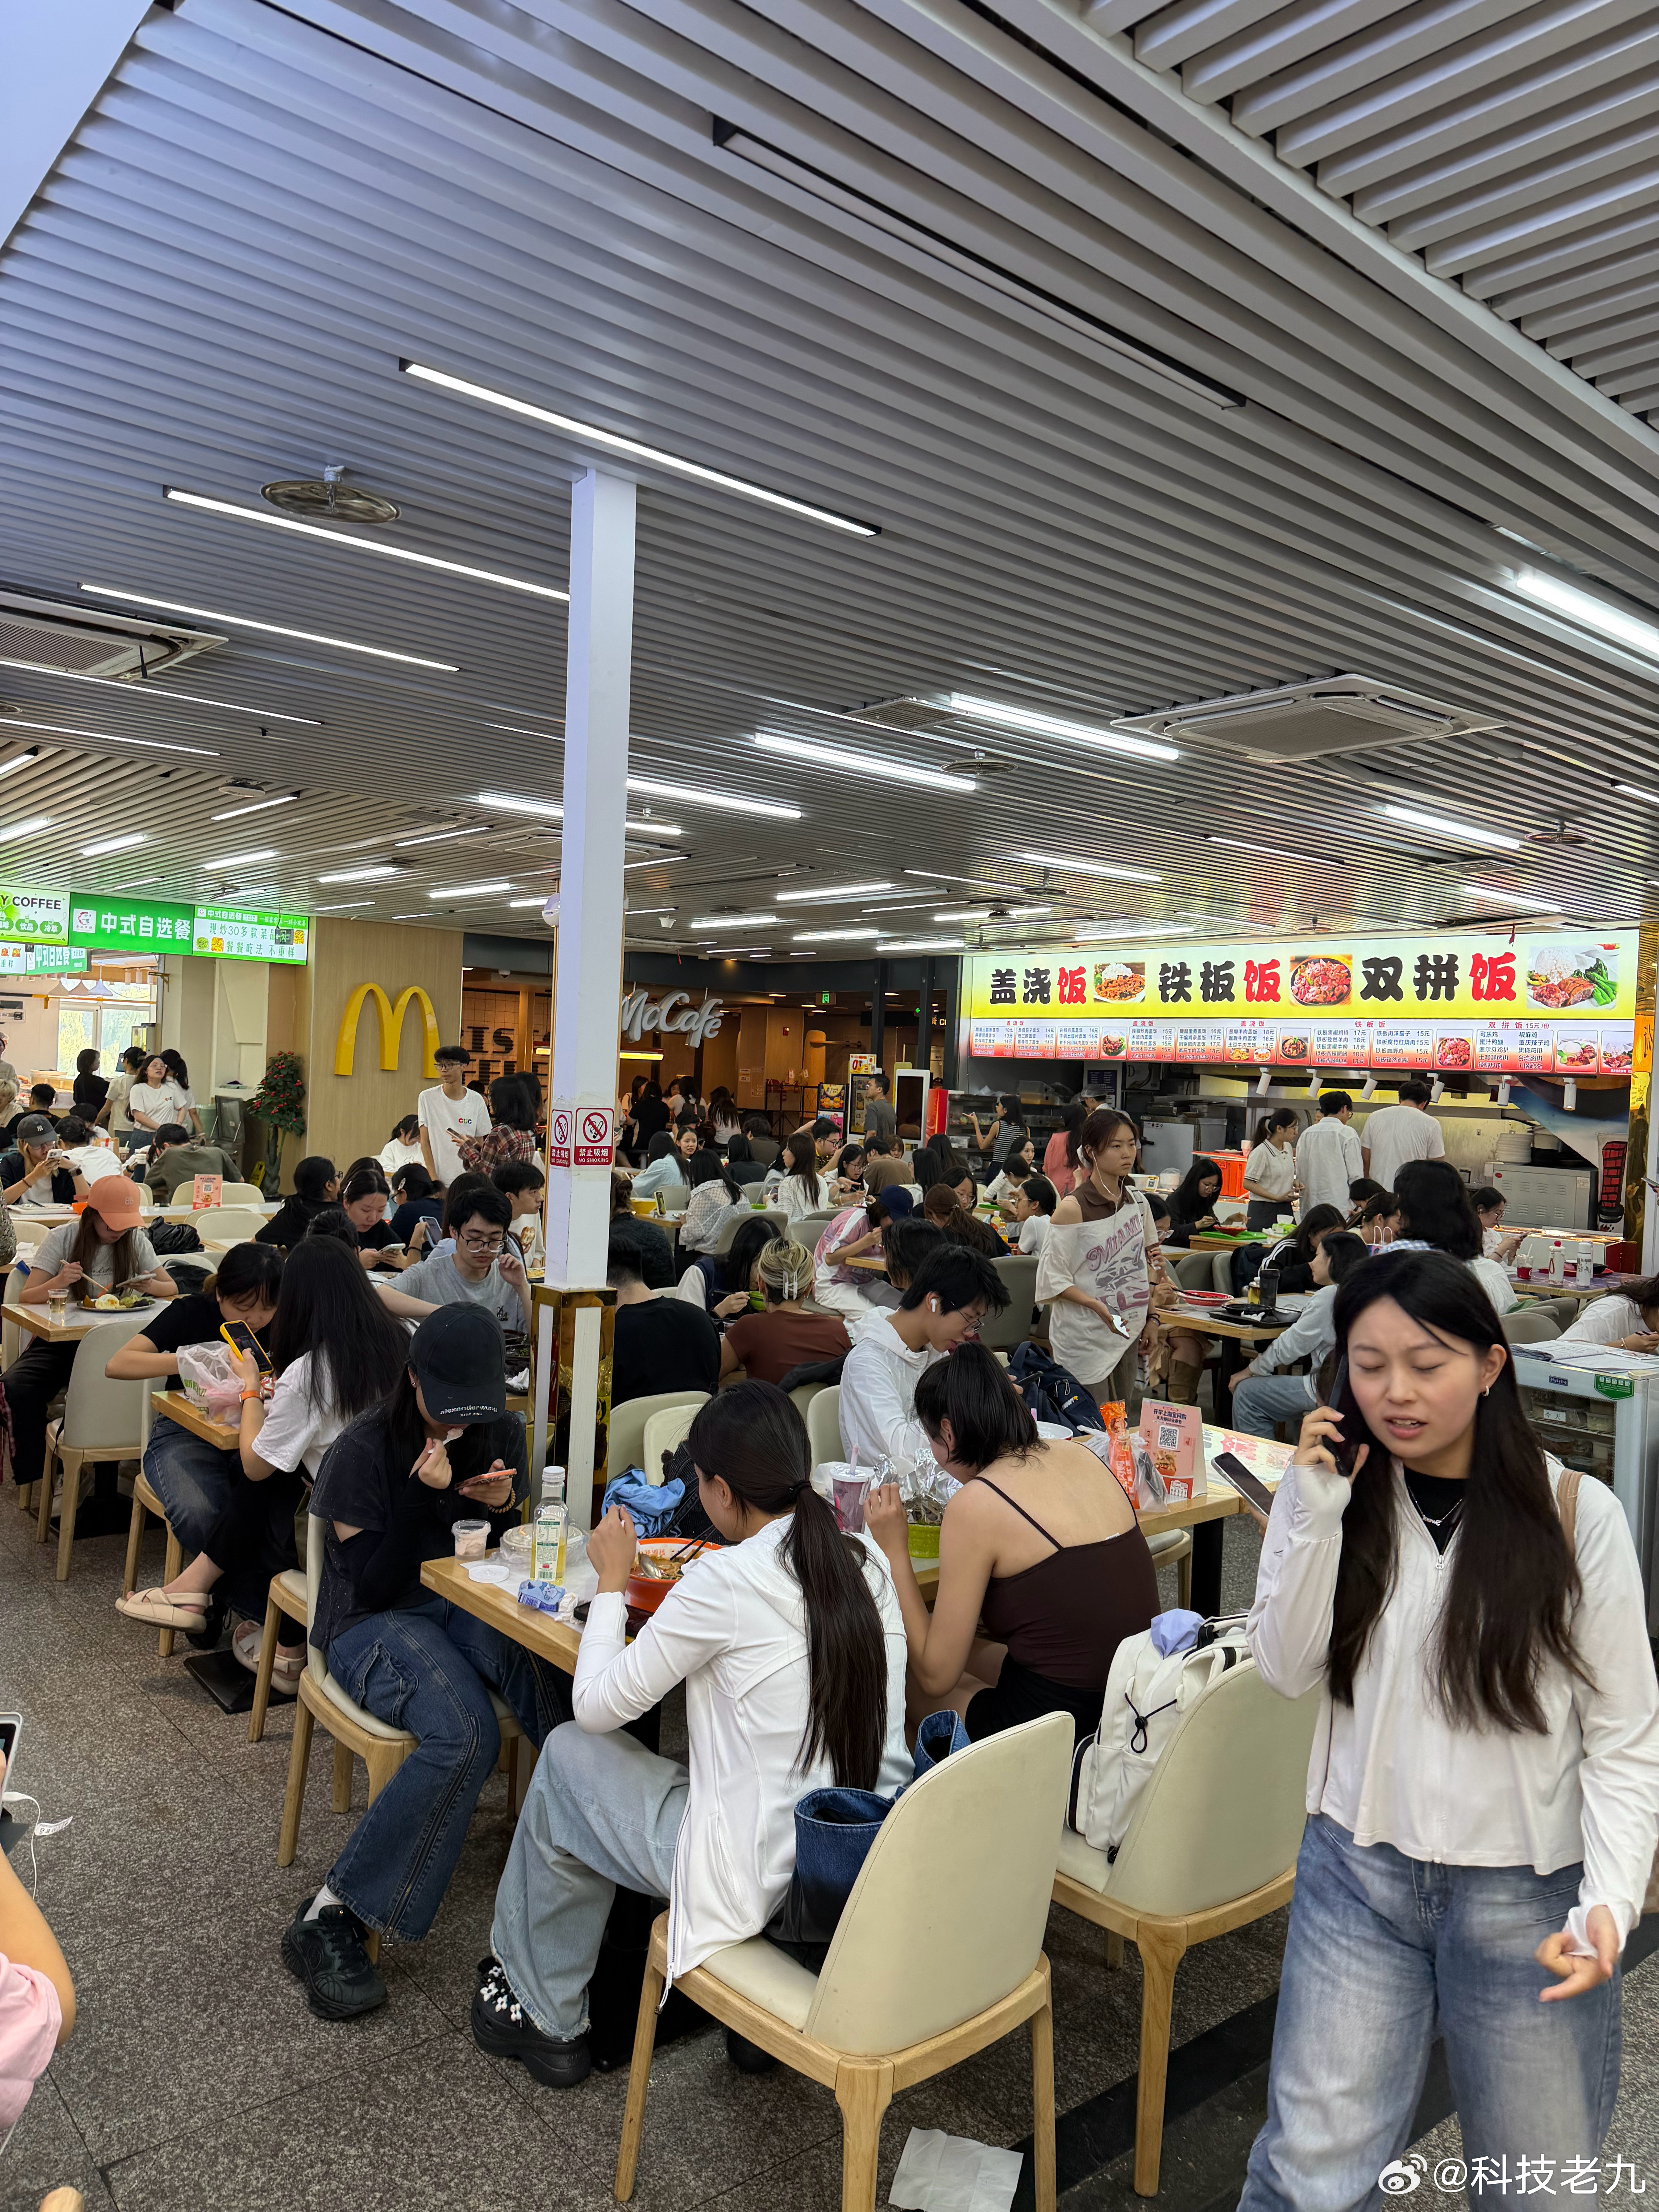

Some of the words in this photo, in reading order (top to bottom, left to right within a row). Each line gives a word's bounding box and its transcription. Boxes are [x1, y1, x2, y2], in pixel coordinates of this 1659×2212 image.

[12, 896, 61, 910] COFFEE
[20, 922, 34, 931] 饮品
[101, 912, 191, 940] 中式自选餐
[989, 966, 1088, 1005] 盖浇饭
[1158, 958, 1281, 1003] 铁板饭
[1360, 951, 1517, 1002] 双拼饭
[552, 1148, 568, 1159] 禁止吸烟
[579, 1148, 608, 1157] 禁止吸烟
